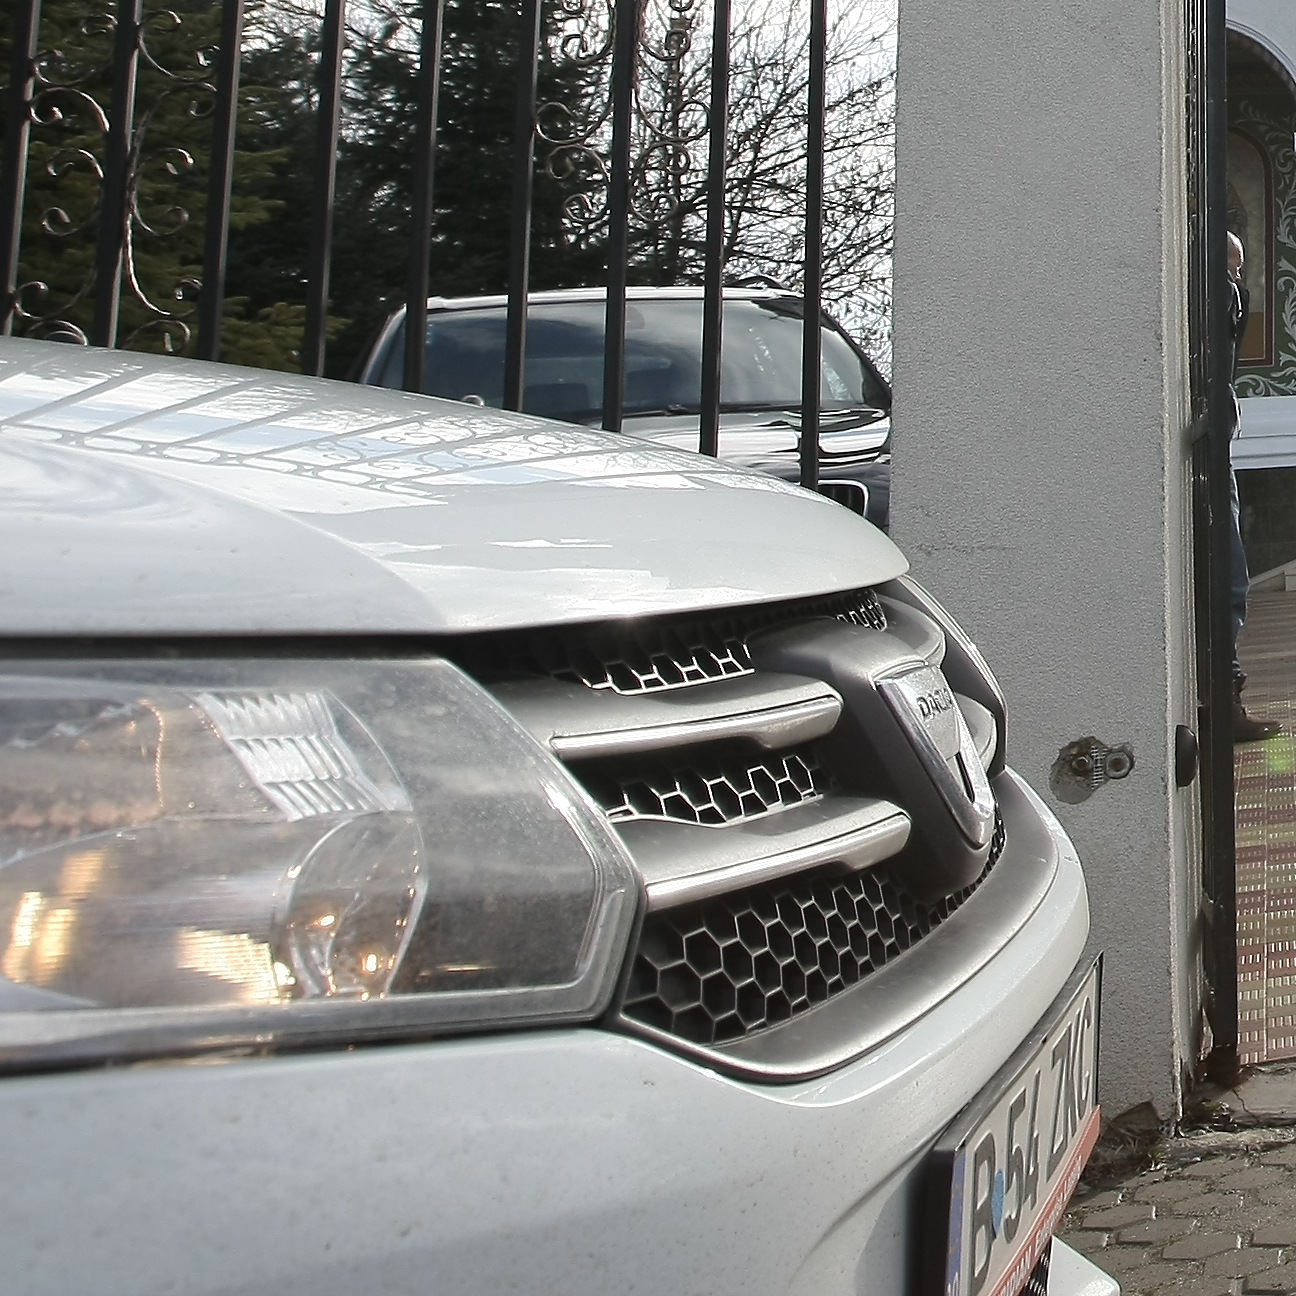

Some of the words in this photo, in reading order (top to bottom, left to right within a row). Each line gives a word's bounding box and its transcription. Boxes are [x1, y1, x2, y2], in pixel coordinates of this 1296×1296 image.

[969, 1131, 997, 1296] B
[1002, 1068, 1040, 1245] 54
[1045, 995, 1093, 1184] ZKC
